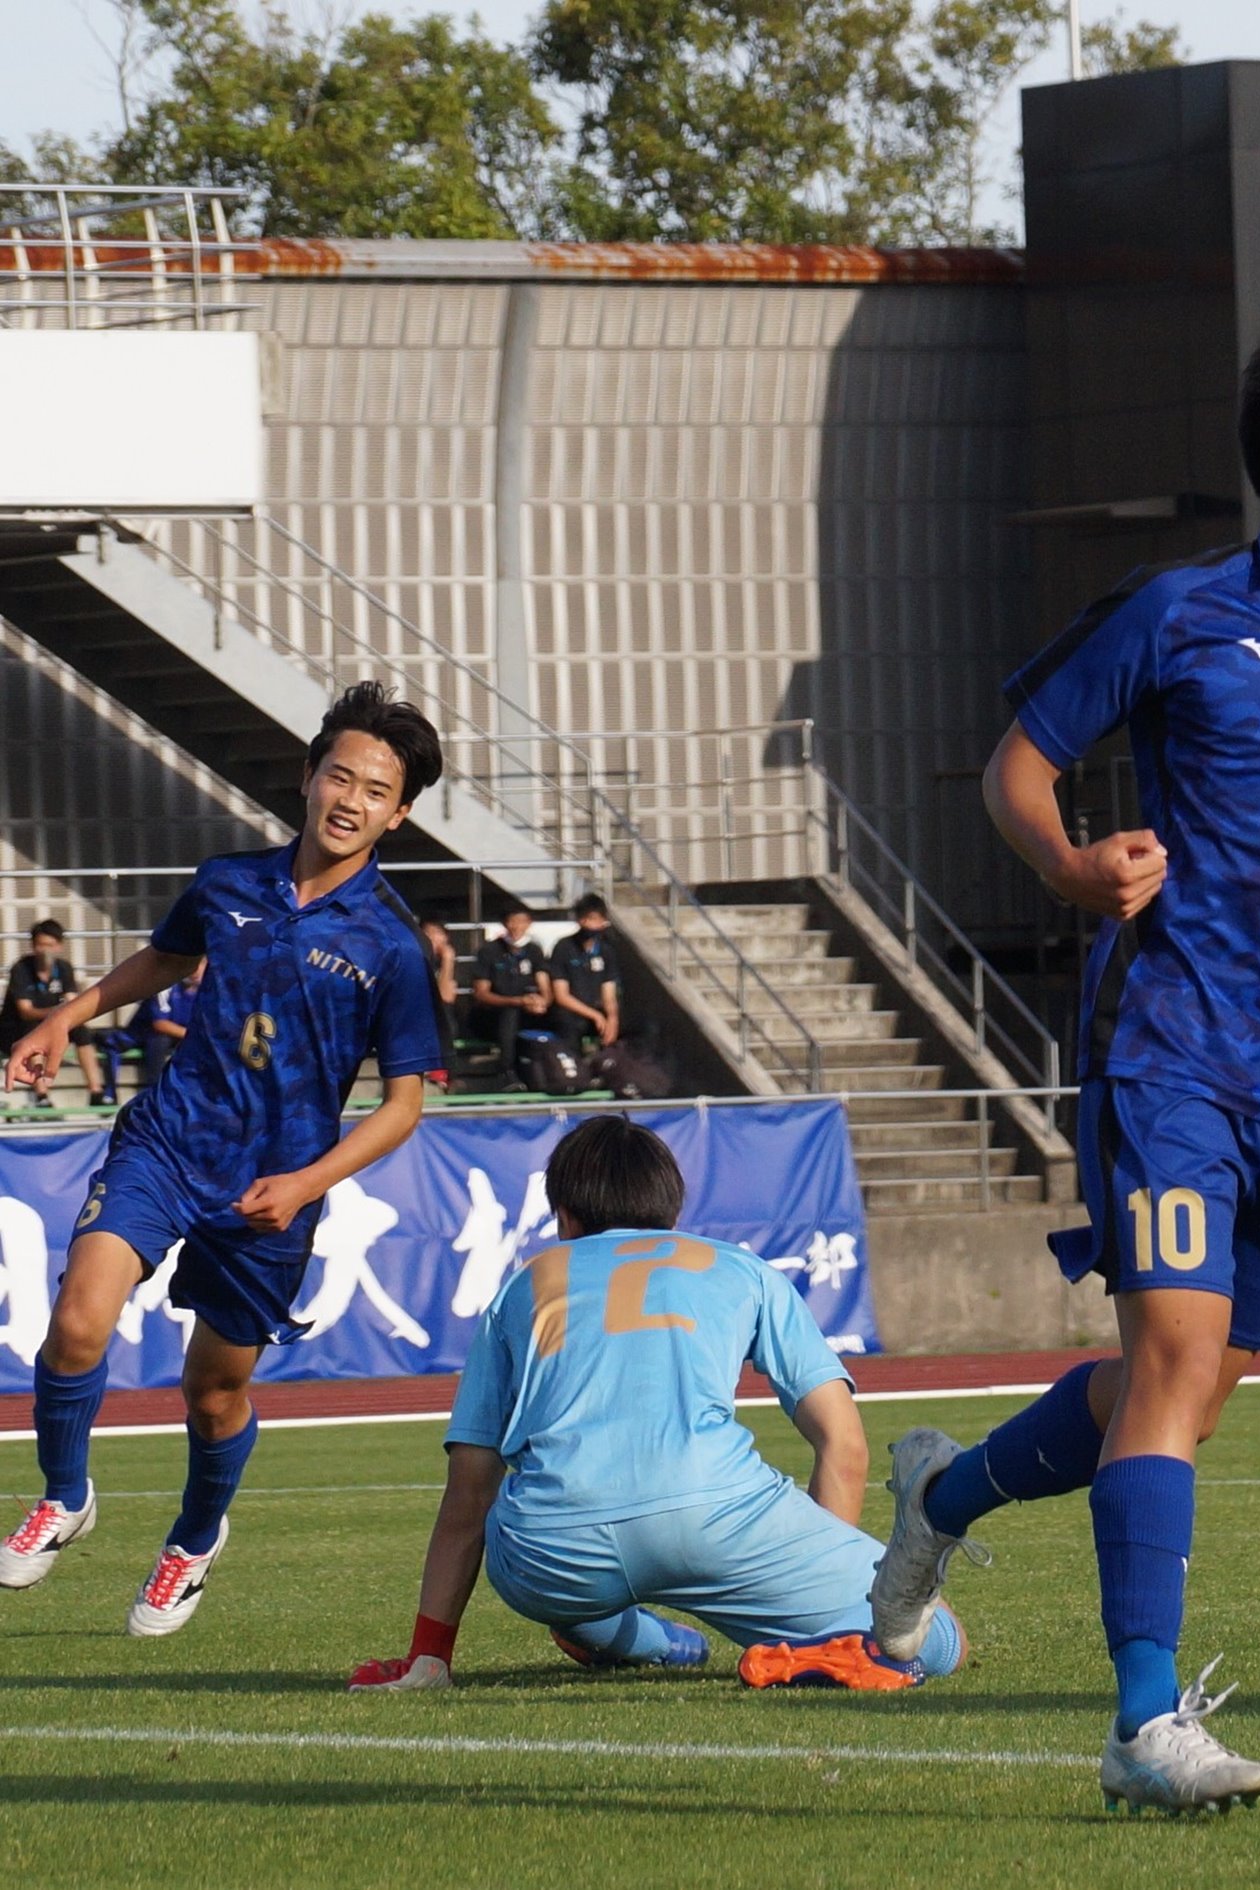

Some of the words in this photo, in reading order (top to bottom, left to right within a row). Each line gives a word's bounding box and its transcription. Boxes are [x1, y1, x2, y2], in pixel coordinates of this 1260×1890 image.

[238, 1011, 278, 1071] 6
[1127, 1186, 1207, 1273] 10
[522, 1236, 717, 1361] 12
